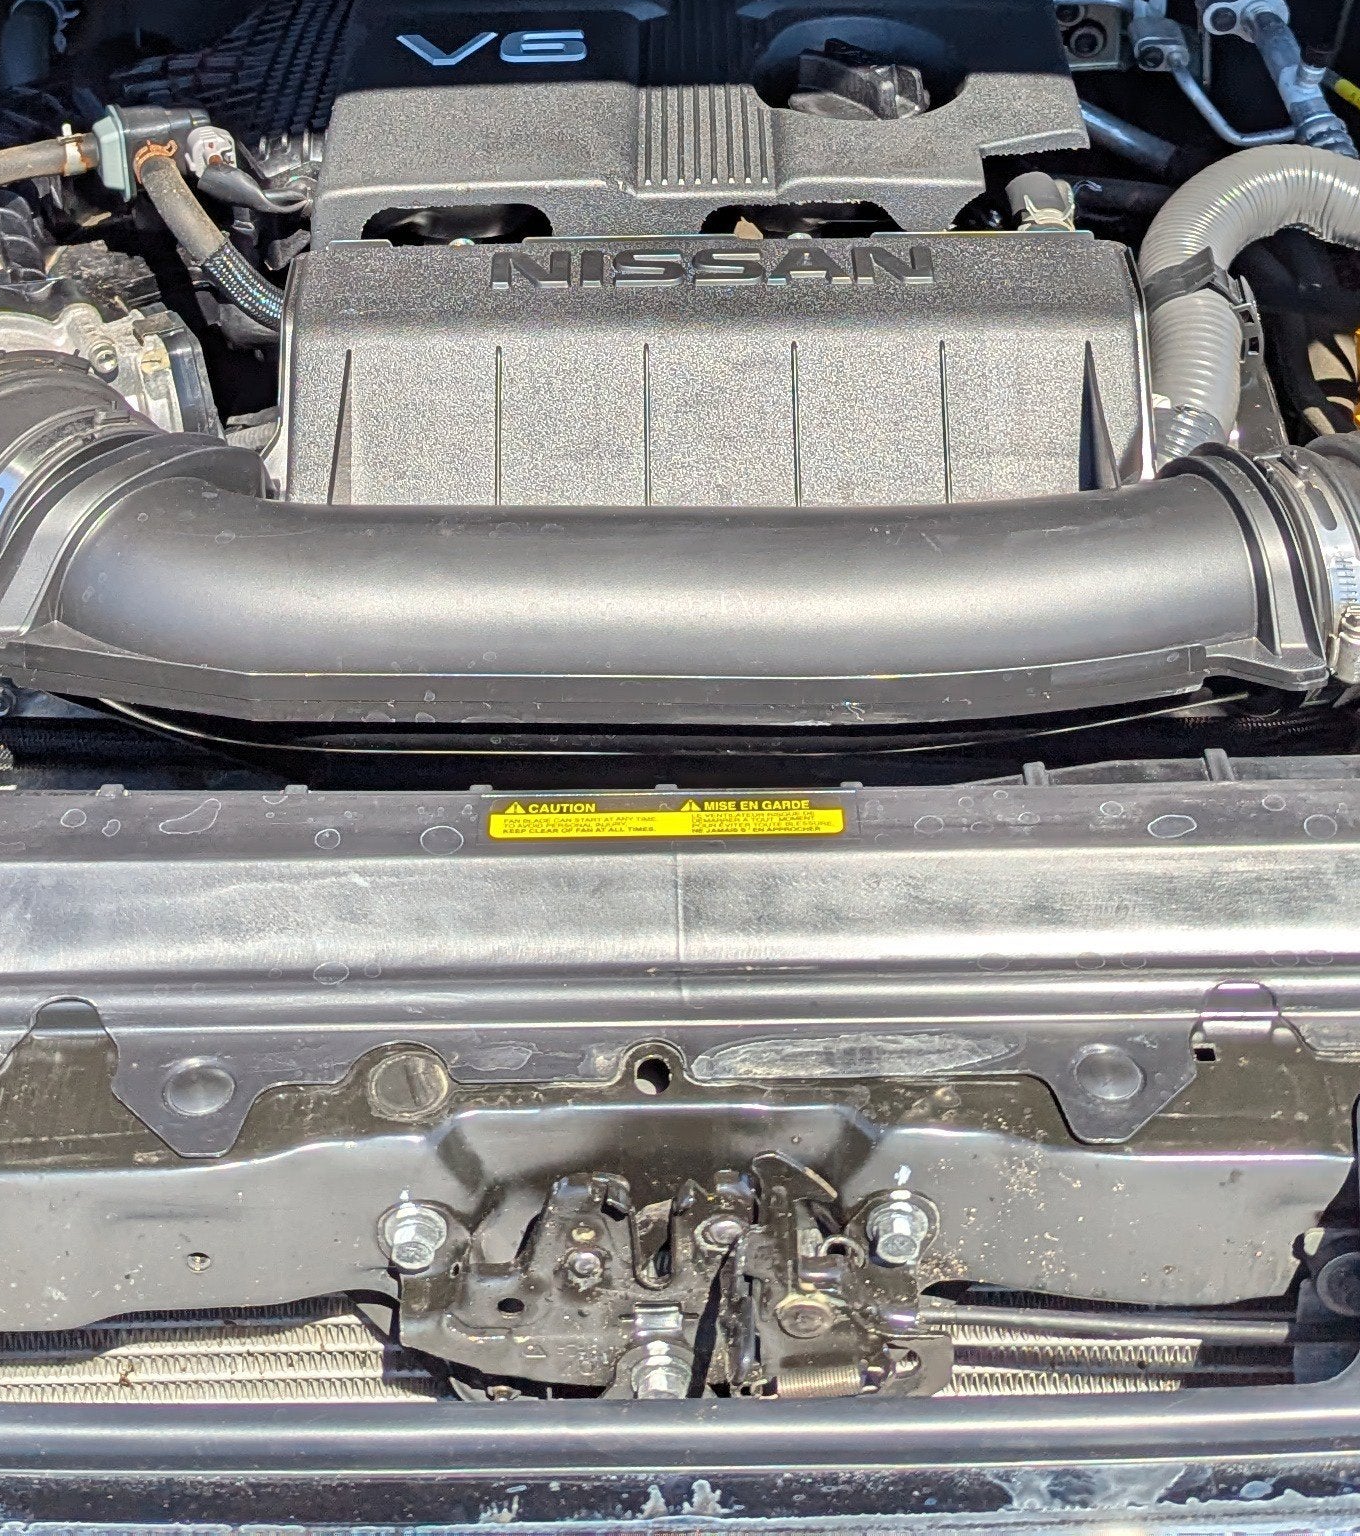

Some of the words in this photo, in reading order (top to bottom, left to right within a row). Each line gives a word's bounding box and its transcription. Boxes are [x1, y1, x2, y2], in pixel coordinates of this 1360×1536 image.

[396, 28, 588, 66] V6
[490, 245, 936, 290] NISSAN
[528, 803, 596, 814] CAUTION
[704, 801, 736, 811] MISE
[740, 801, 759, 811] EN
[762, 800, 810, 810] GARDE
